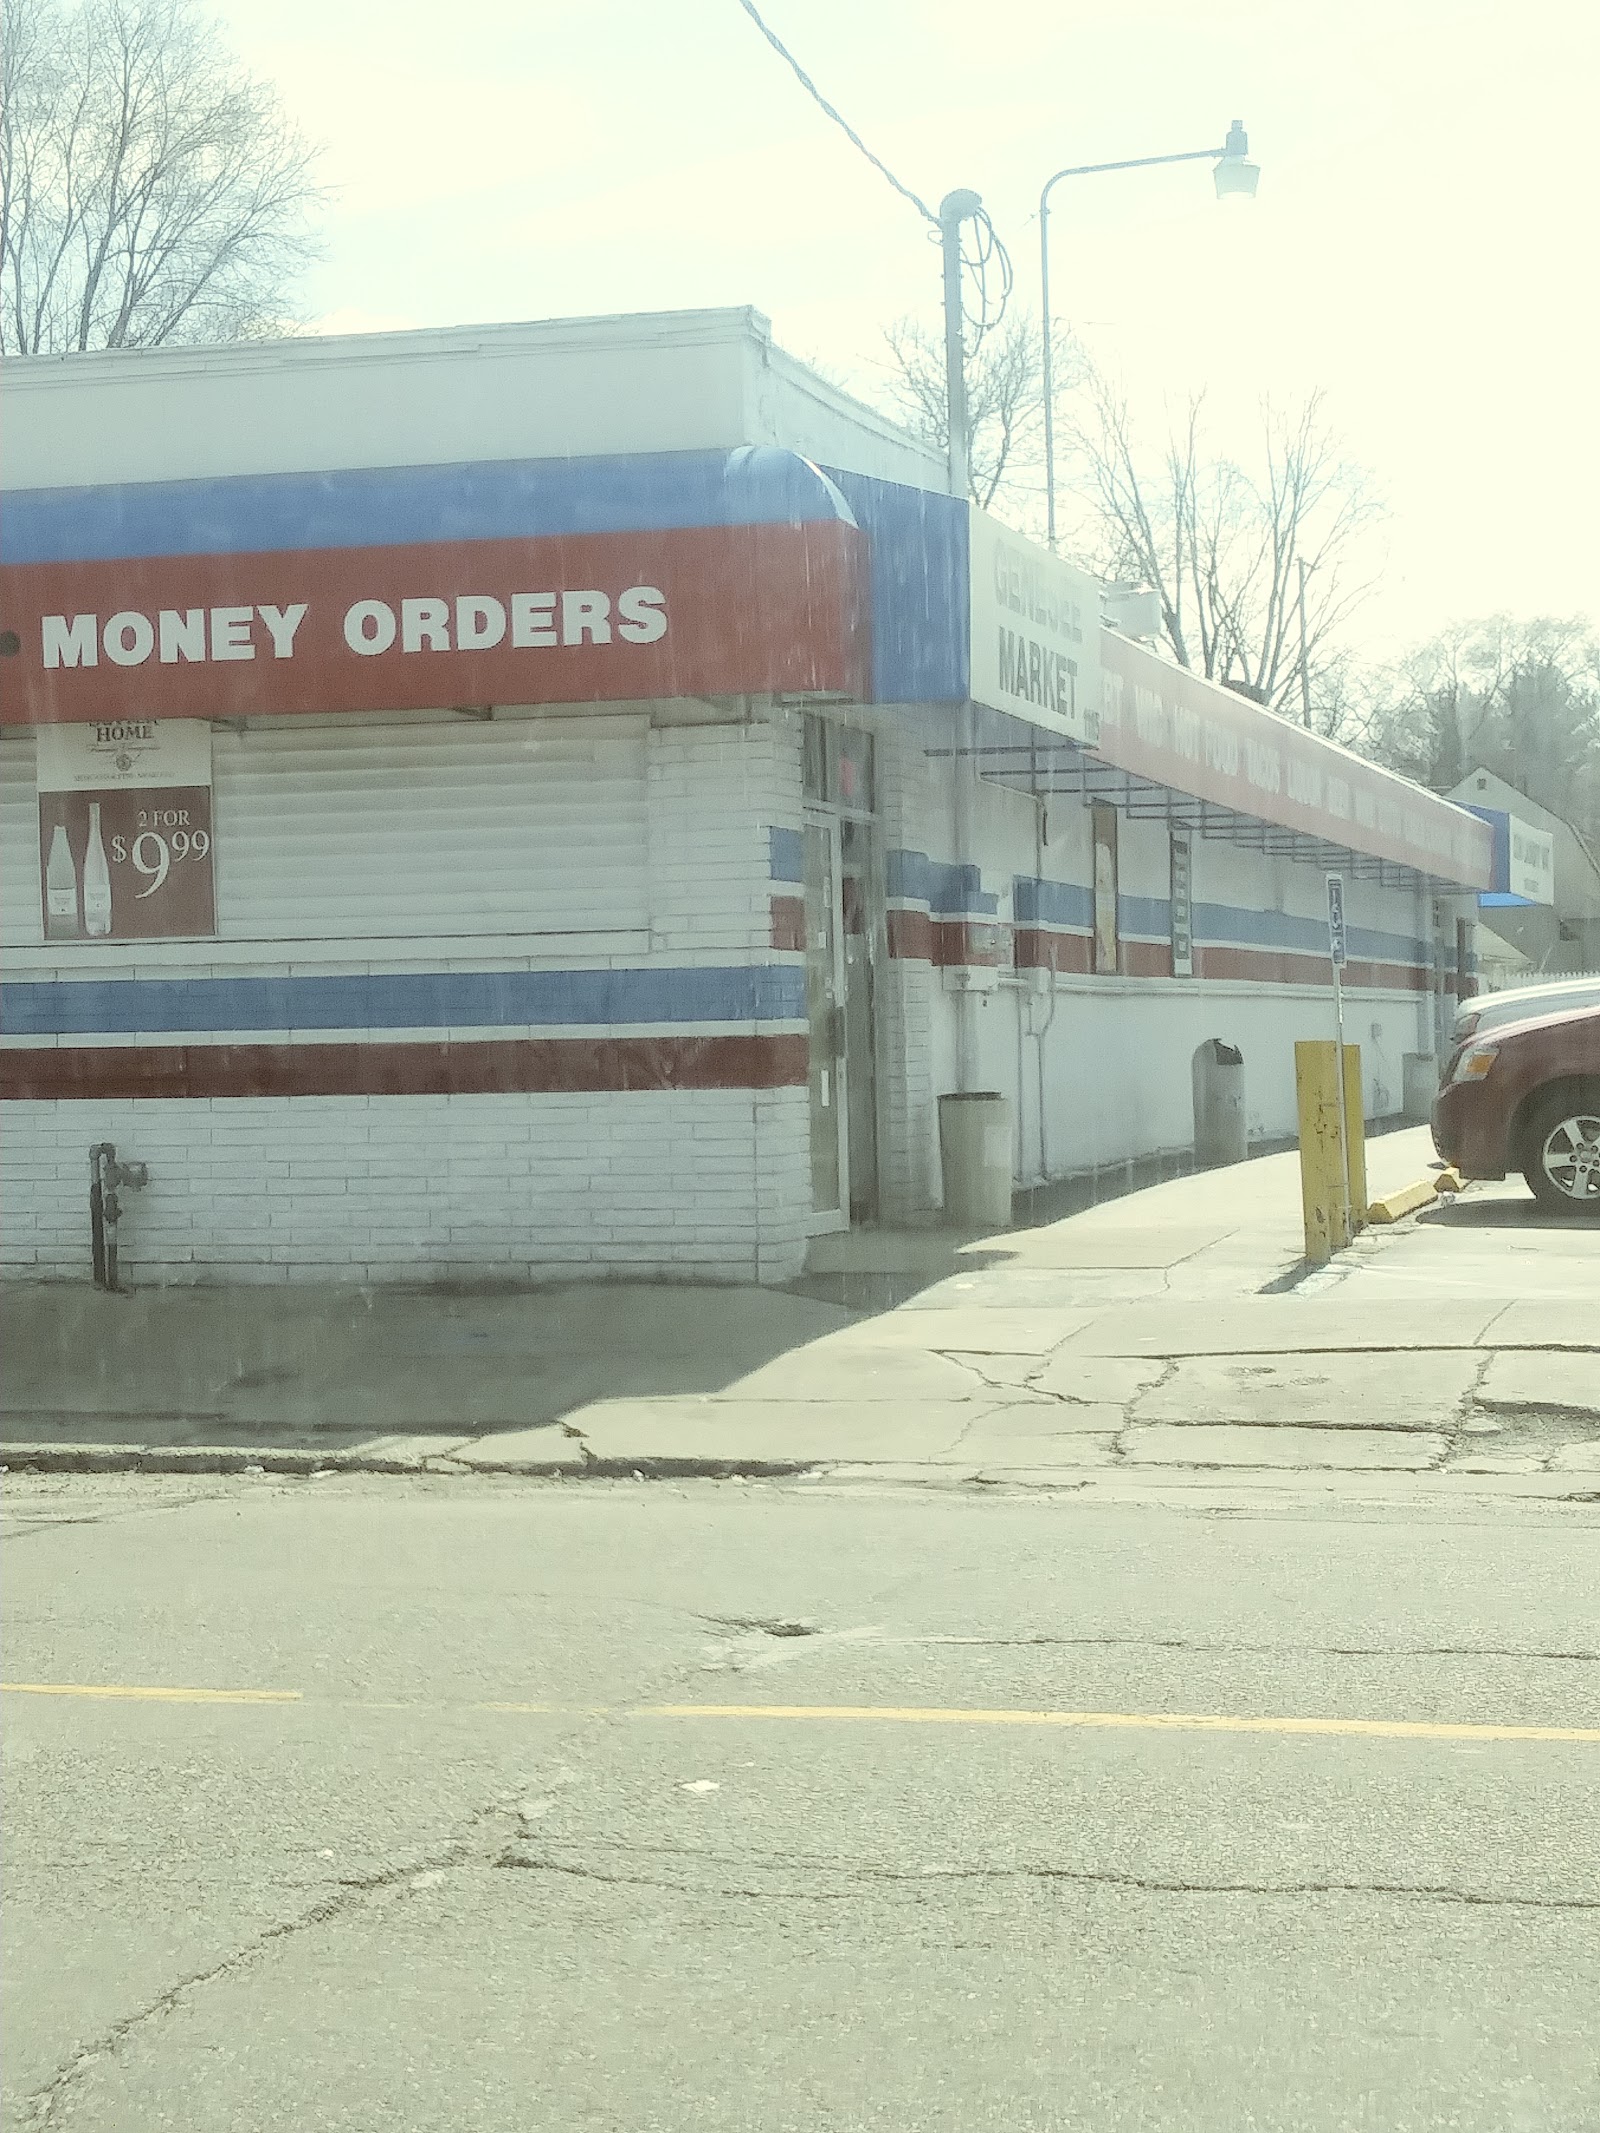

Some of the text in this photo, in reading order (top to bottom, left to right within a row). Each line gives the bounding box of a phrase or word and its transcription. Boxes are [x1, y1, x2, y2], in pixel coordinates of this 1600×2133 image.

[41, 586, 669, 669] MONEY ORDERS
[999, 626, 1078, 720] MARKET
[96, 724, 155, 742] HOME
[138, 808, 192, 828] 2 FOR
